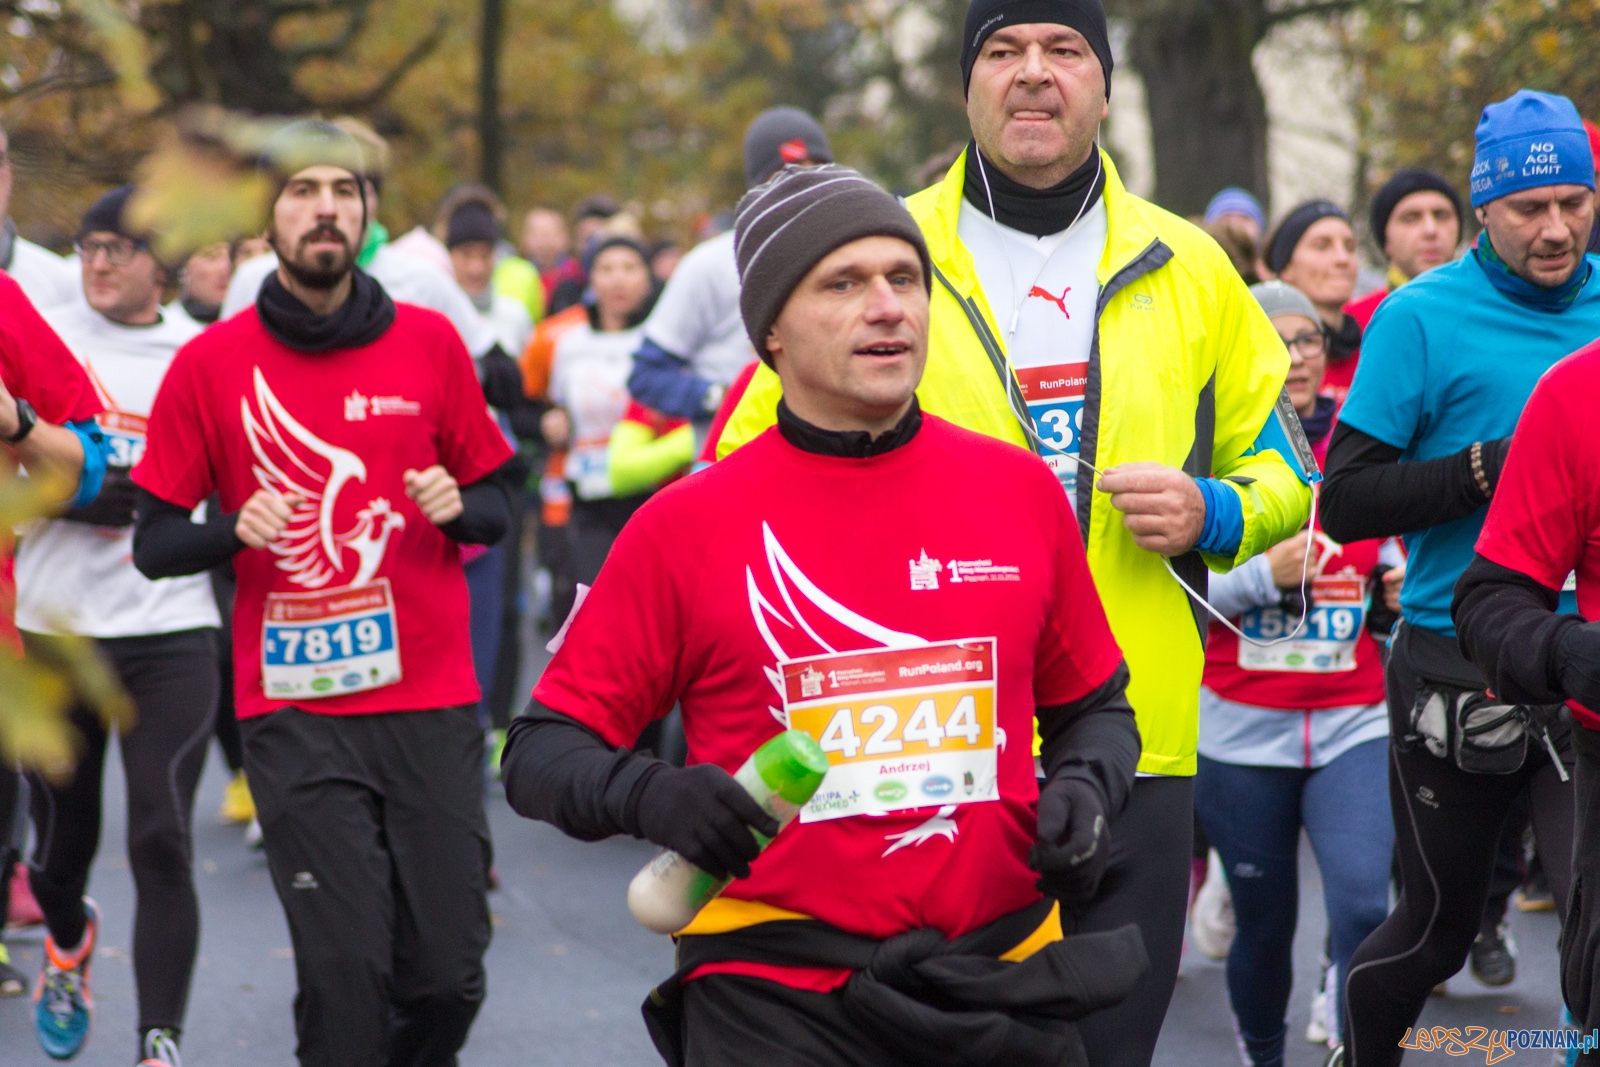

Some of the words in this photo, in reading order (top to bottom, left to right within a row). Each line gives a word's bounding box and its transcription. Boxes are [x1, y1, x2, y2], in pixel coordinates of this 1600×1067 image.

[1530, 142, 1554, 153] NO
[1525, 153, 1558, 165] AGE
[1521, 164, 1562, 177] LIMIT
[946, 559, 963, 583] 1
[1259, 607, 1354, 640] 5819
[278, 617, 382, 664] 7819
[898, 659, 983, 678] RunPoland.org
[827, 669, 840, 688] 1
[818, 694, 982, 759] 4244
[879, 760, 931, 775] Andrzej
